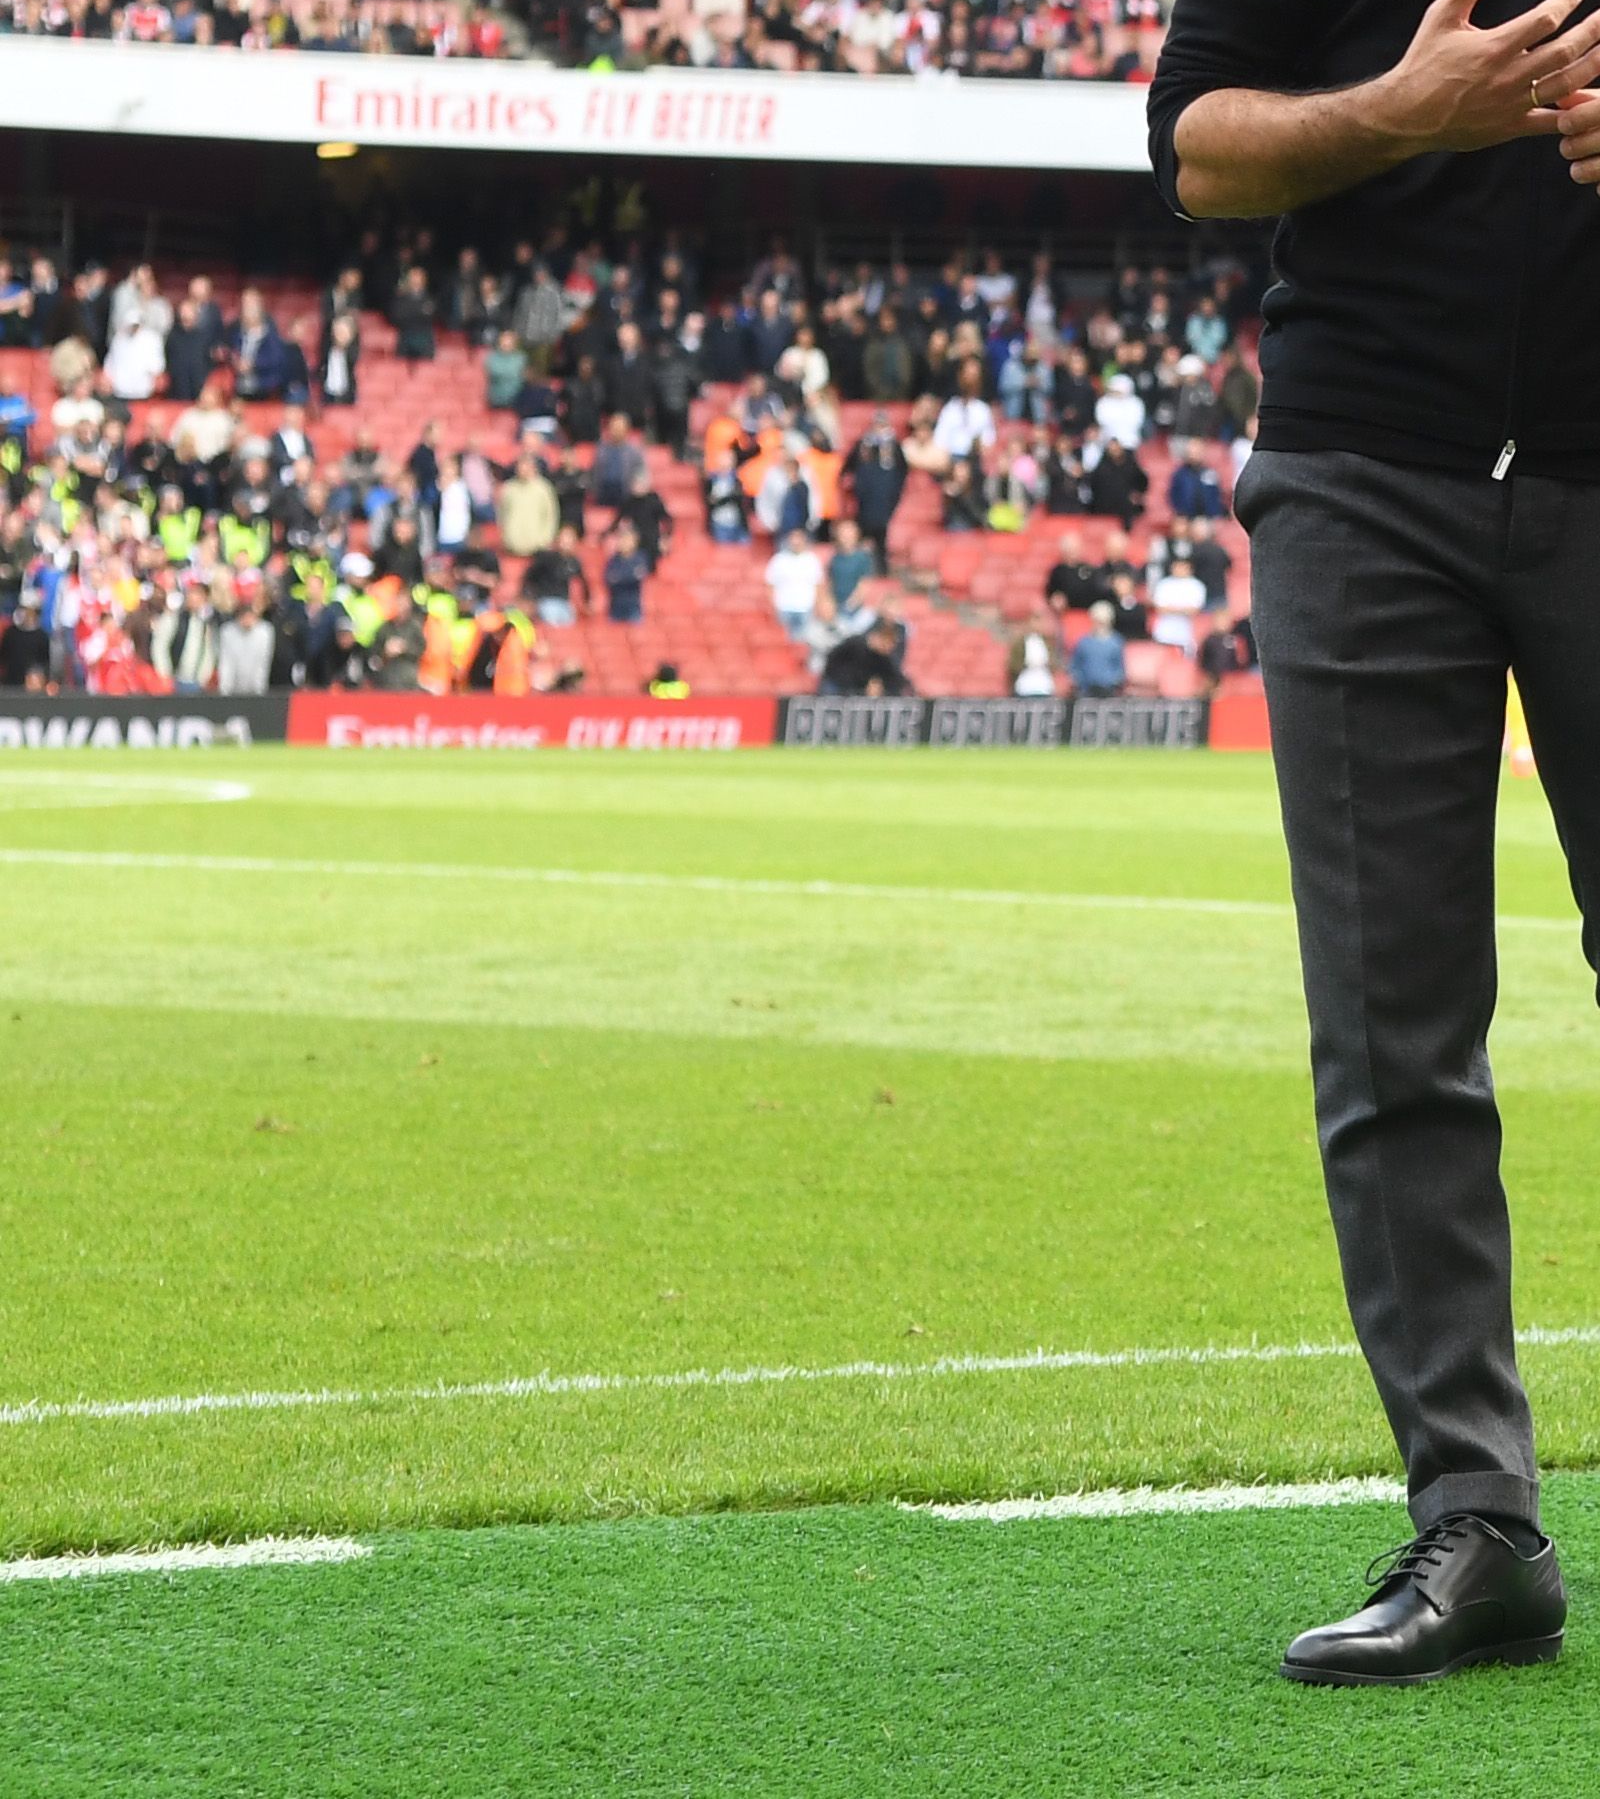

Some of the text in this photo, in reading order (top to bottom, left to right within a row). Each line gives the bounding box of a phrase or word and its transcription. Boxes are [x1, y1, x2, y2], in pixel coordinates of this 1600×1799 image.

[315, 76, 778, 143] Emirates FLY BETTER
